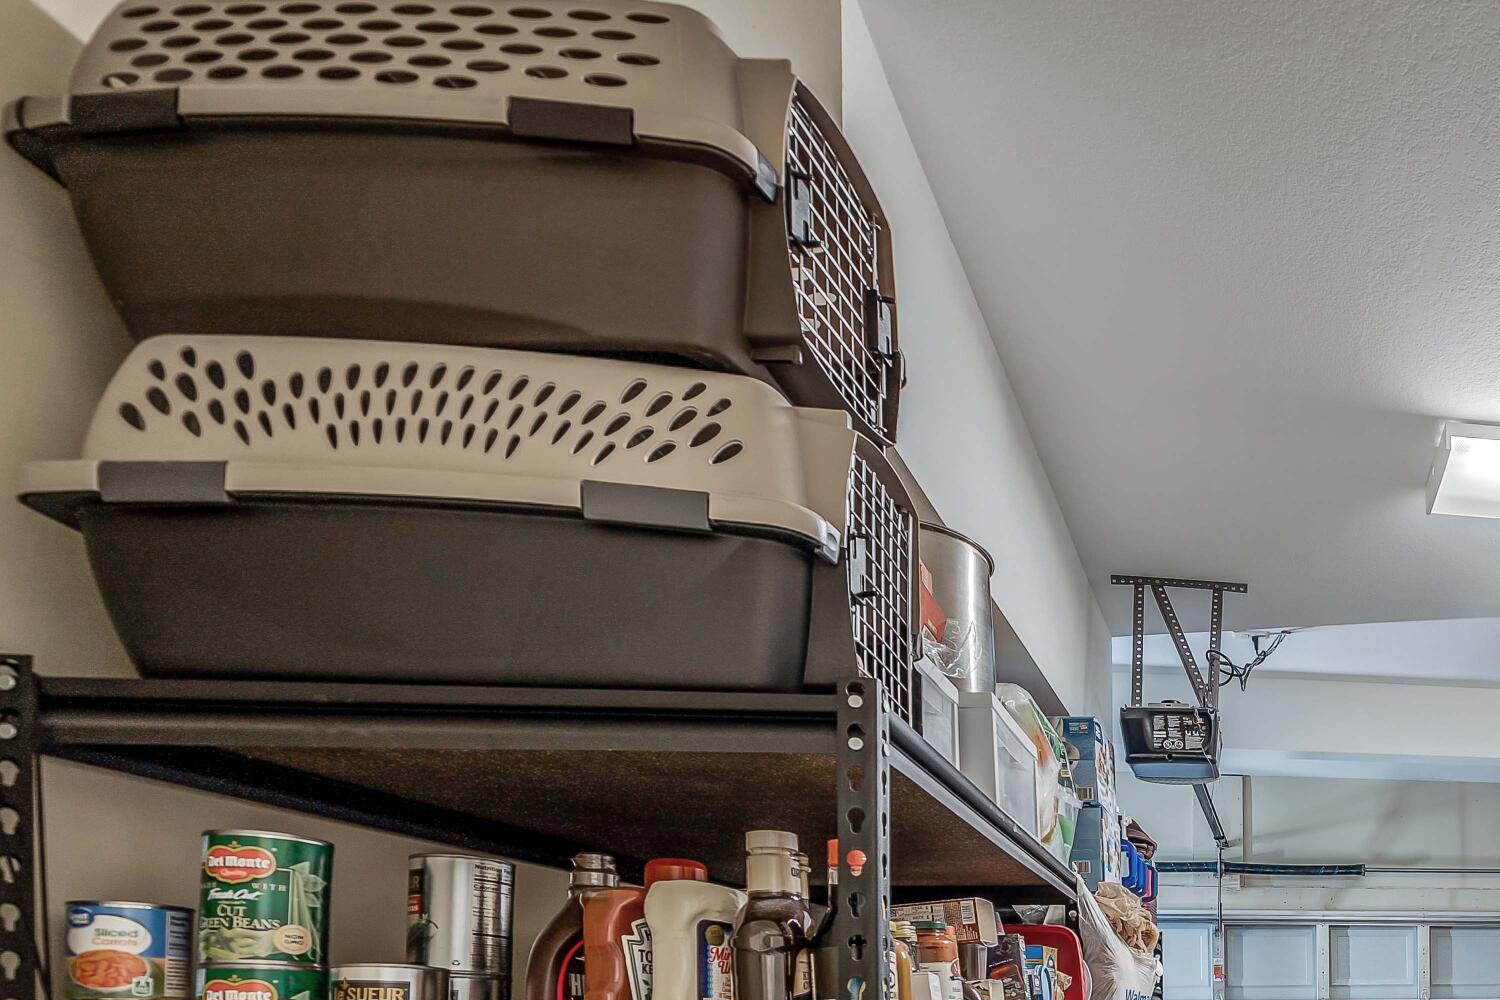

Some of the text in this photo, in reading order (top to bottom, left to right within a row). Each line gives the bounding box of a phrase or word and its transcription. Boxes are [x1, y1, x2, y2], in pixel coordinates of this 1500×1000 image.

[225, 855, 271, 868] Monte
[251, 882, 287, 892] WITH
[216, 904, 248, 917] CUT
[232, 915, 281, 930] BEANS
[94, 927, 139, 938] Sliced
